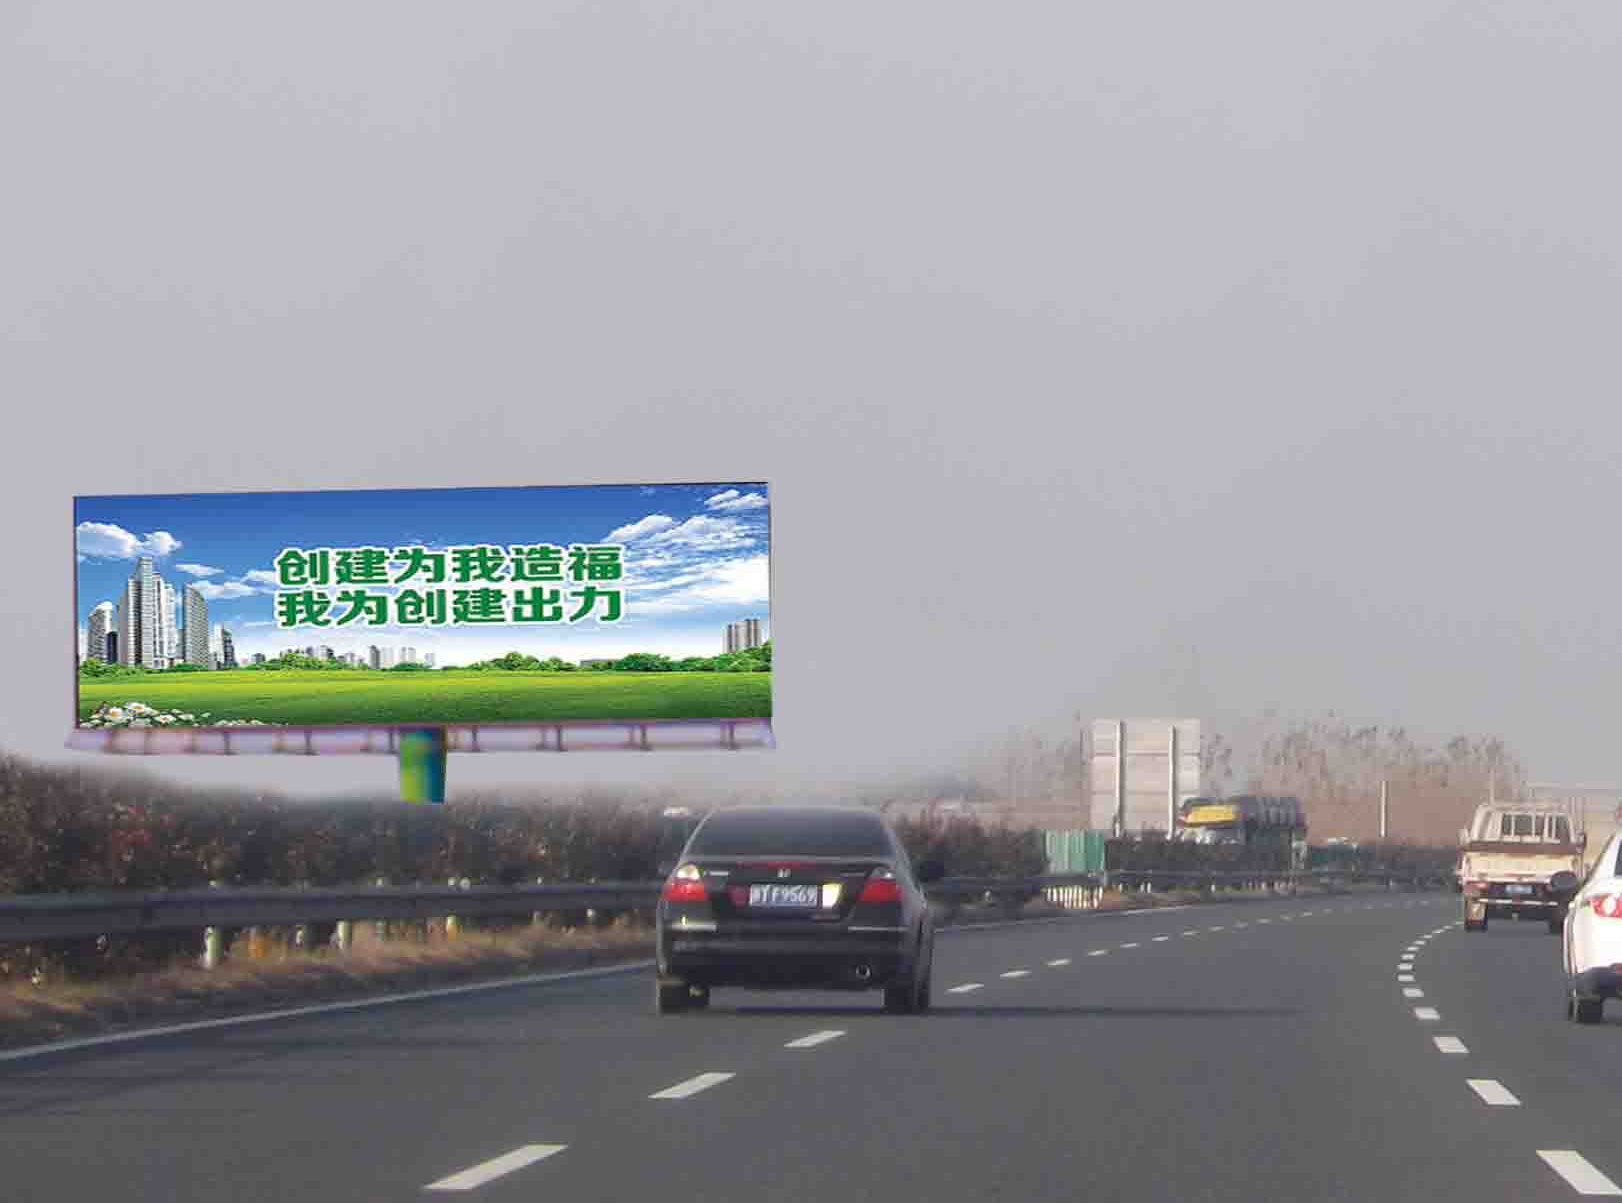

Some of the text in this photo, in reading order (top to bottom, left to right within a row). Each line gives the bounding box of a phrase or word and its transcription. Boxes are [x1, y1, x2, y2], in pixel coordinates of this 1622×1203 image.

[278, 547, 623, 587] 创建为我造福
[278, 587, 623, 628] 我为创建出力
